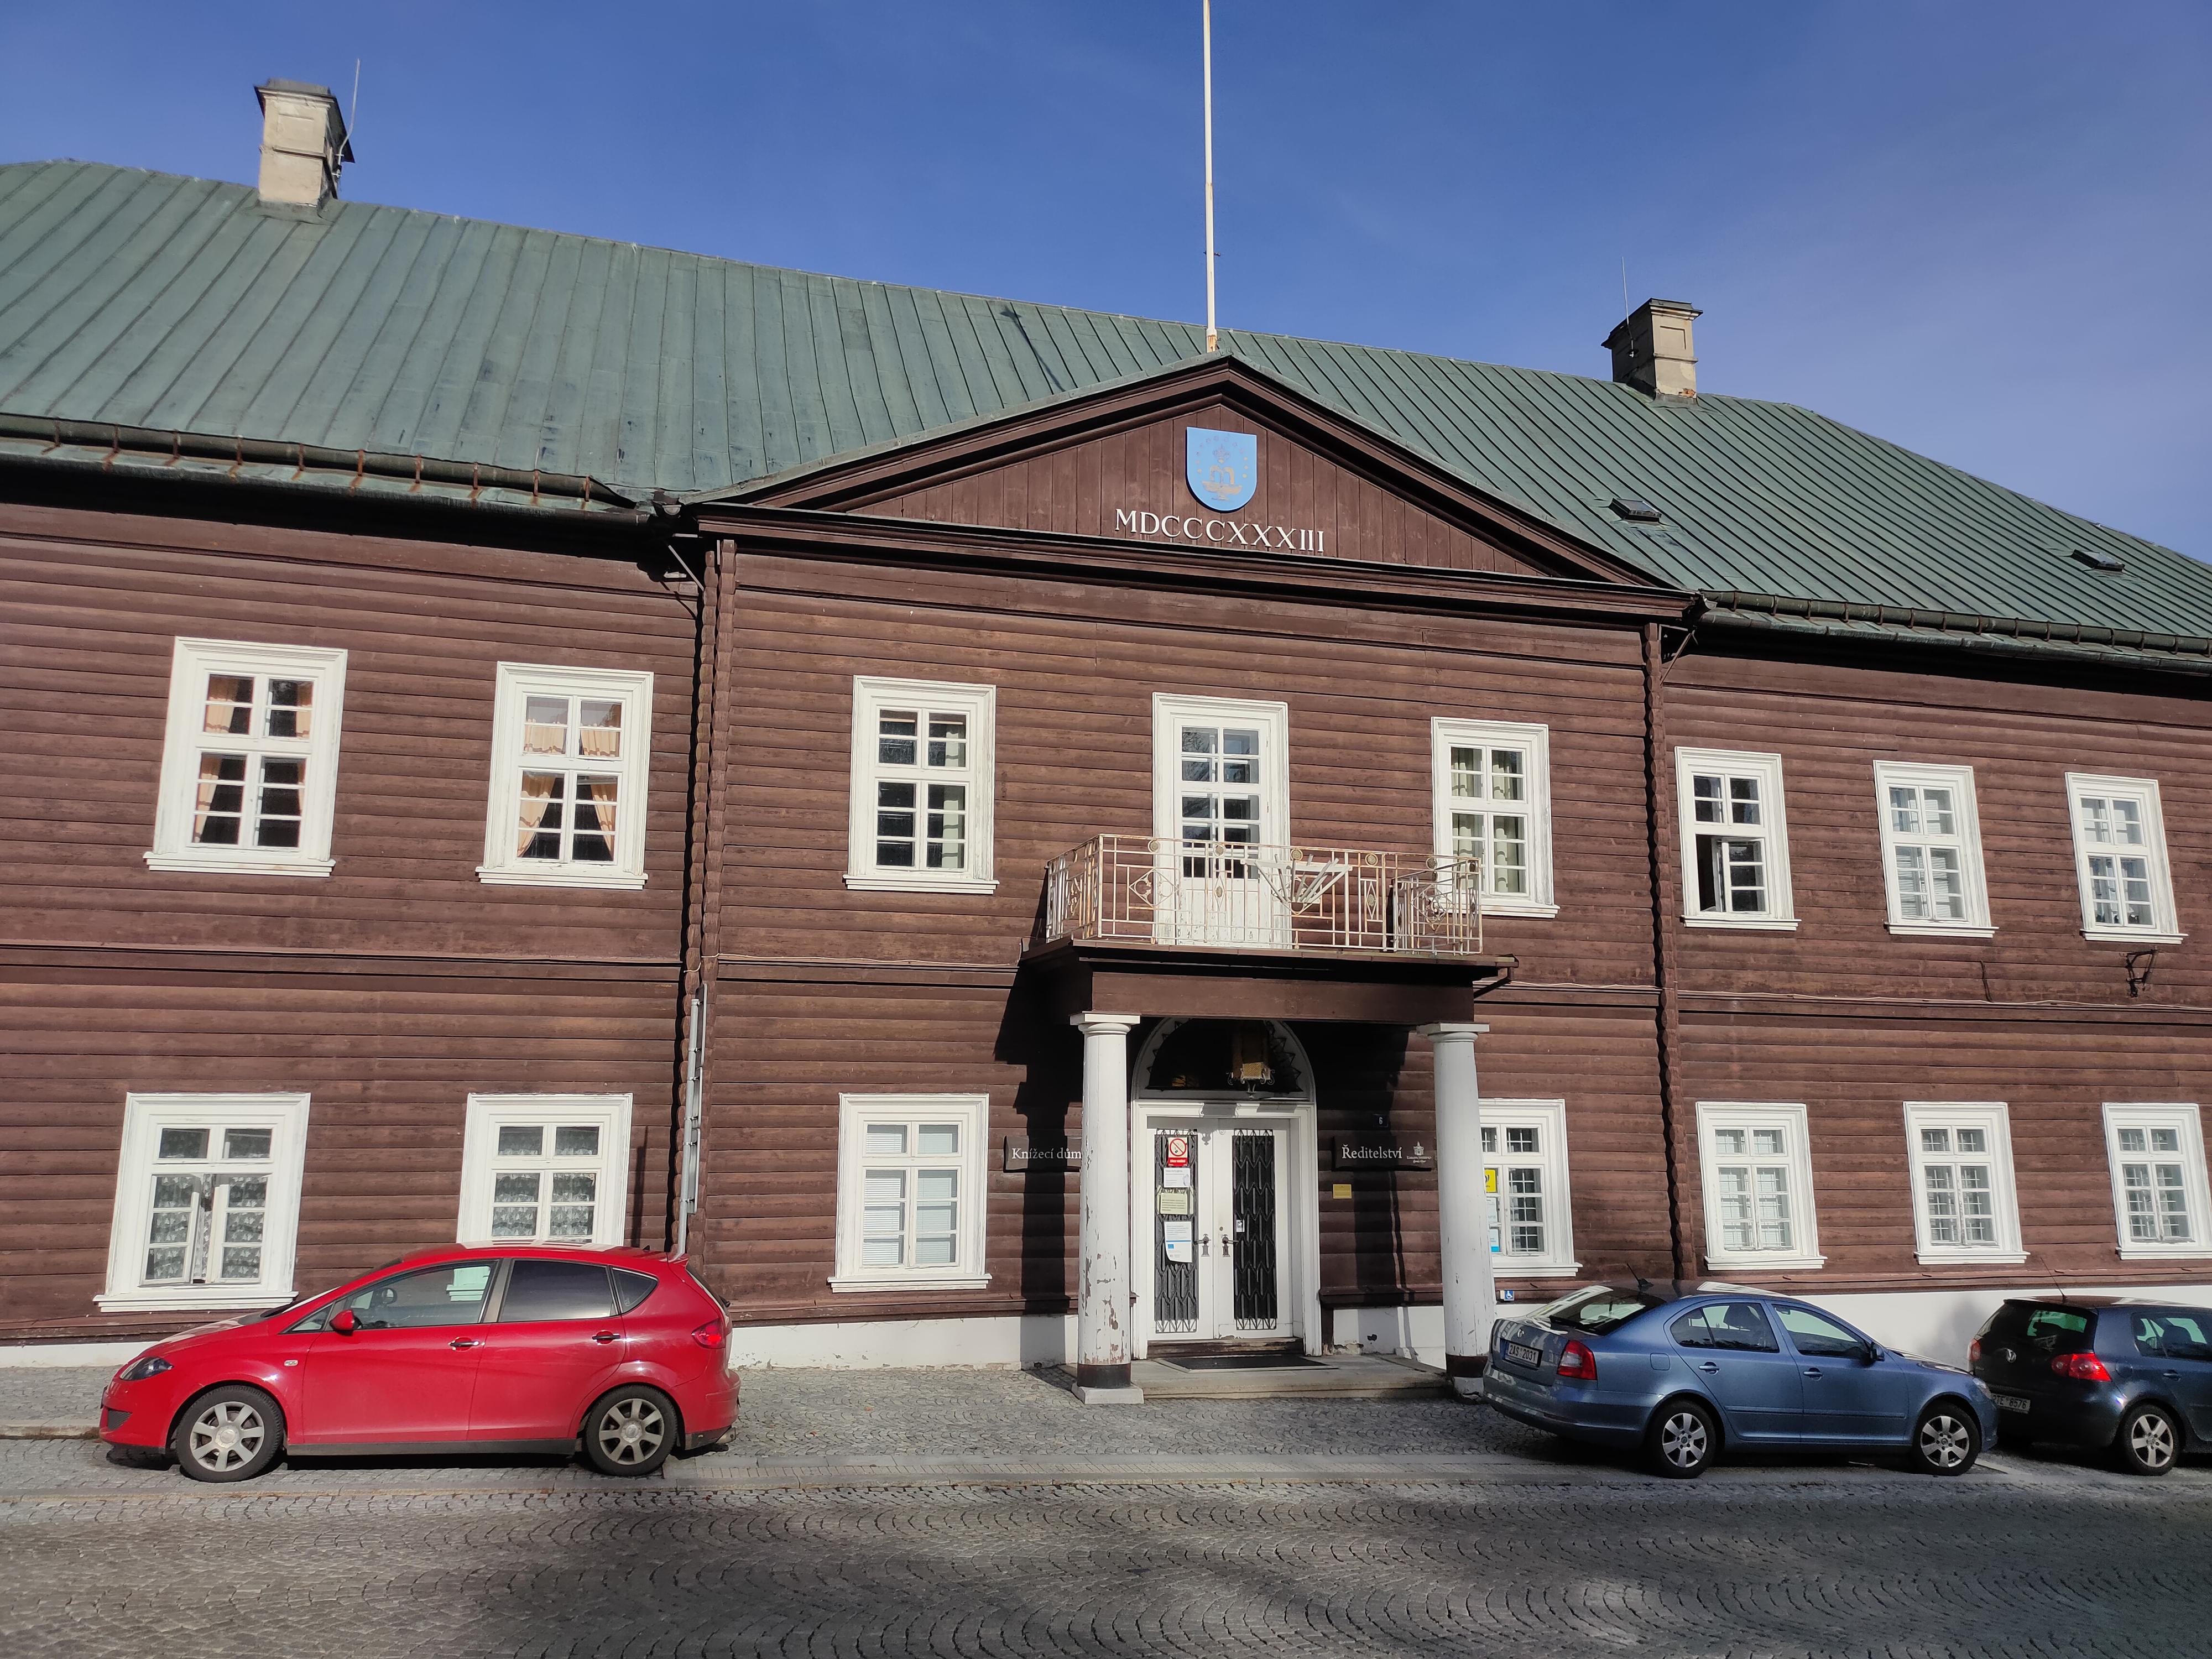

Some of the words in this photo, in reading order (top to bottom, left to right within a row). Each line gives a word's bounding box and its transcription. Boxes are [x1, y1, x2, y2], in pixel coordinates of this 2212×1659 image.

[1115, 508, 1324, 552] MDCCCXXXIII
[1379, 1117, 1383, 1125] 6
[1011, 1147, 1054, 1159] Knížecí
[1057, 1147, 1082, 1159] dům
[1342, 1144, 1402, 1159] Ředitelství
[1522, 1349, 1536, 1362] 2031
